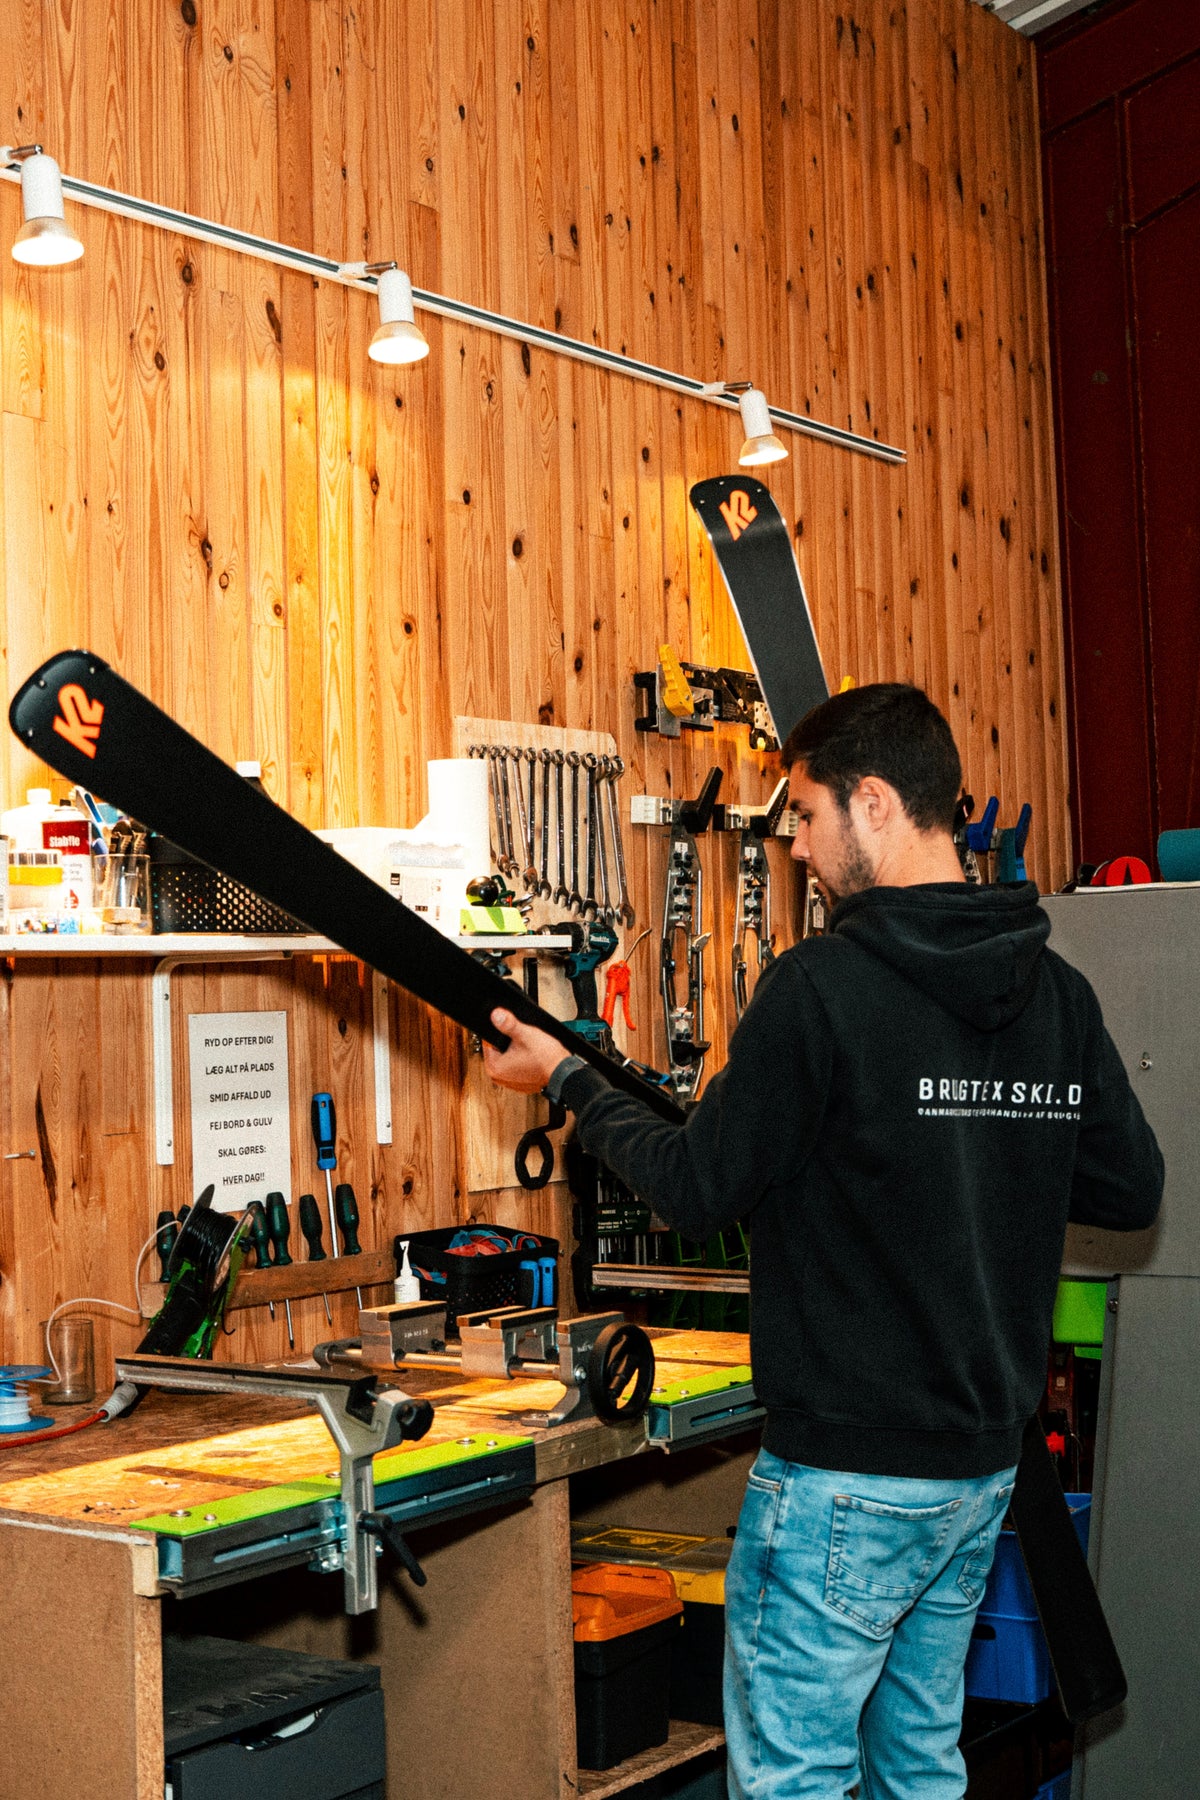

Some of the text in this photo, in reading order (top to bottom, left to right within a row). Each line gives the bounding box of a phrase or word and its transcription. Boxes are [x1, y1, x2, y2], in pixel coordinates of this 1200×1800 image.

[719, 490, 759, 542] K2
[52, 683, 105, 760] K2
[204, 1035, 274, 1047] RYD OP EFTER DIG!
[205, 1062, 275, 1075] LÆG ALT PÅ PLADS
[209, 1090, 272, 1103] SMID AFFALD UD
[210, 1117, 273, 1131] FEJ BORD & GULV
[218, 1145, 267, 1157] SKAL GØRES:
[222, 1172, 265, 1185] HVER DAG!!
